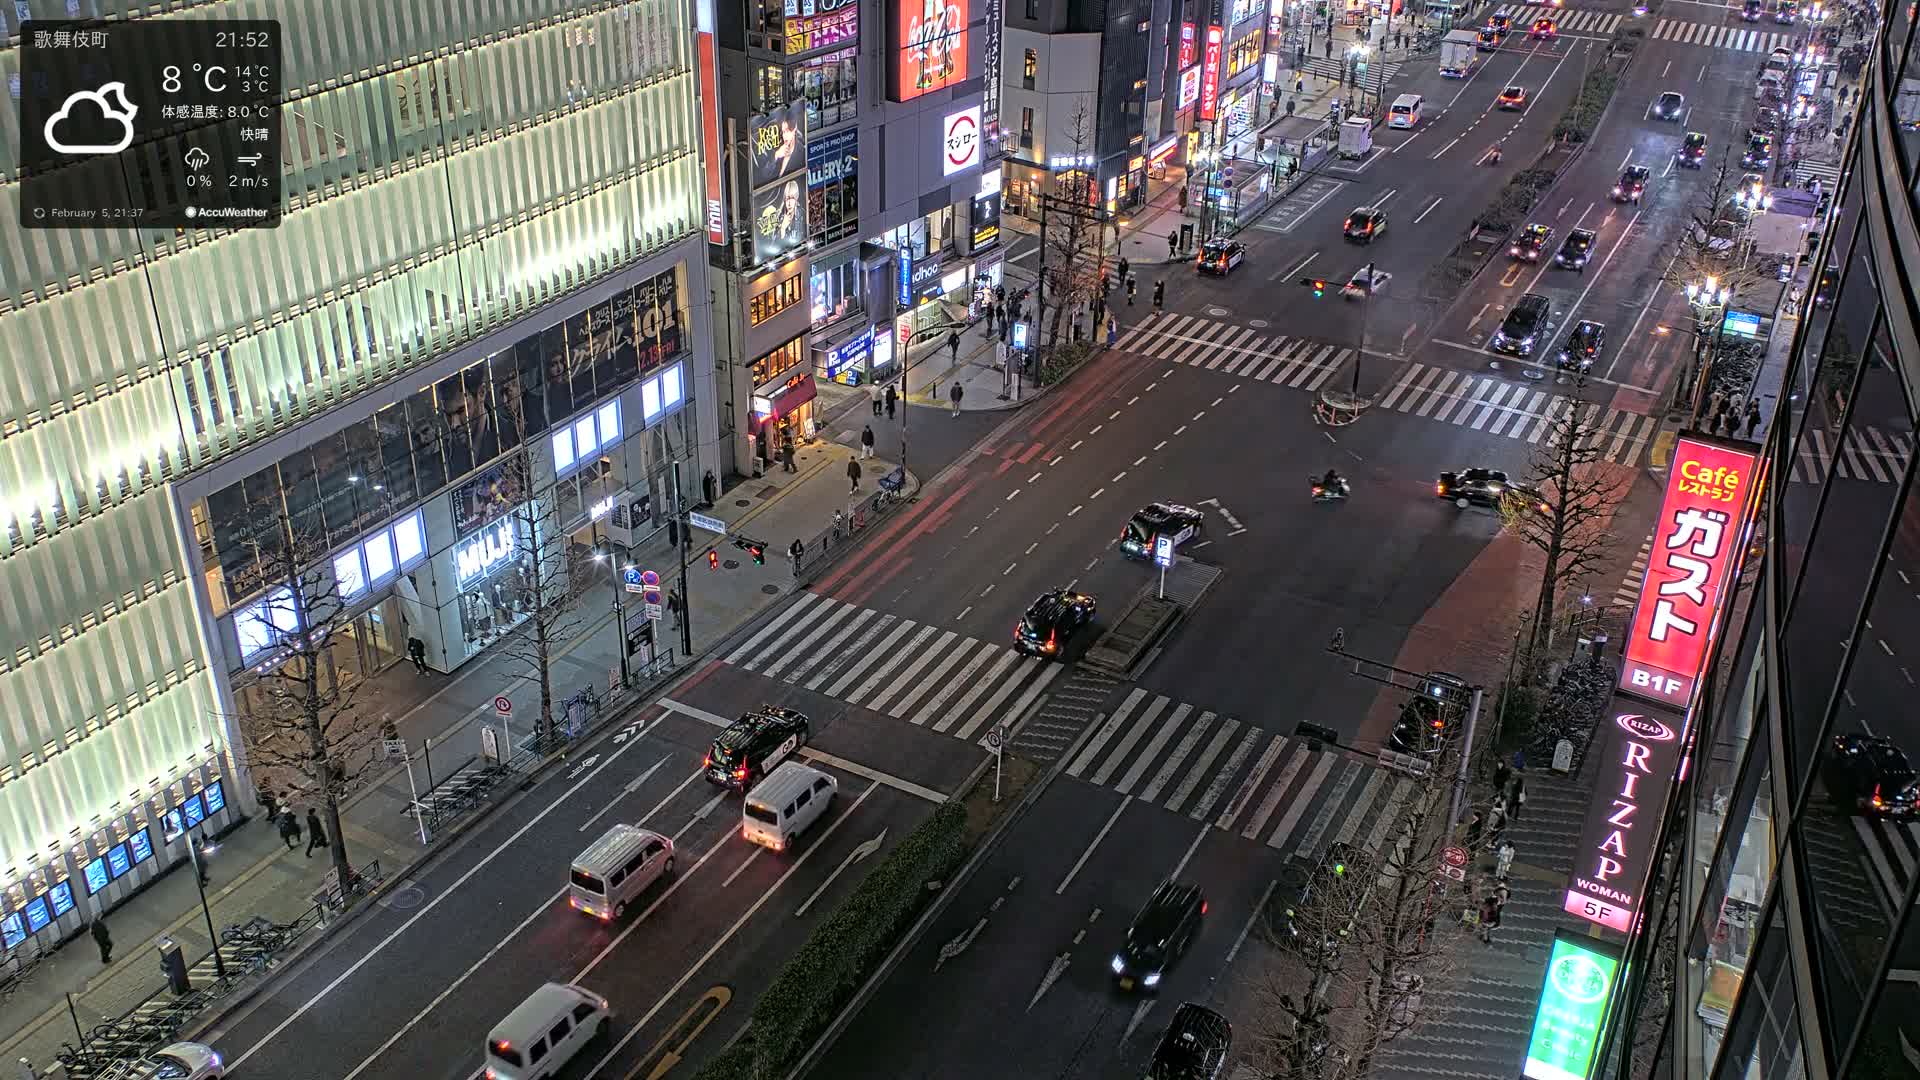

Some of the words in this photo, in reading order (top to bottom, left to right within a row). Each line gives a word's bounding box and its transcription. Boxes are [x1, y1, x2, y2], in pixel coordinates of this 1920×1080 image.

[1204, 46, 1219, 110] バーガーキング
[810, 142, 829, 154] SPORTS
[830, 138, 841, 146] PRO
[841, 133, 855, 143] SHOP
[947, 134, 978, 150] スシロー
[709, 200, 721, 232] MUJI
[595, 306, 610, 319] クリス
[618, 295, 633, 307] マーク
[640, 286, 655, 297] バリー
[1681, 460, 1739, 489] Café
[1678, 479, 1735, 502] レストラン
[591, 496, 613, 519] MUJI
[457, 522, 513, 581] MUJI
[1649, 509, 1727, 642] ガスト
[1632, 669, 1682, 695] B1F
[1630, 720, 1661, 734] RIZAP
[1594, 741, 1652, 881] RIZAP
[1577, 878, 1631, 904] WOMAN
[1584, 902, 1612, 919] 5F
